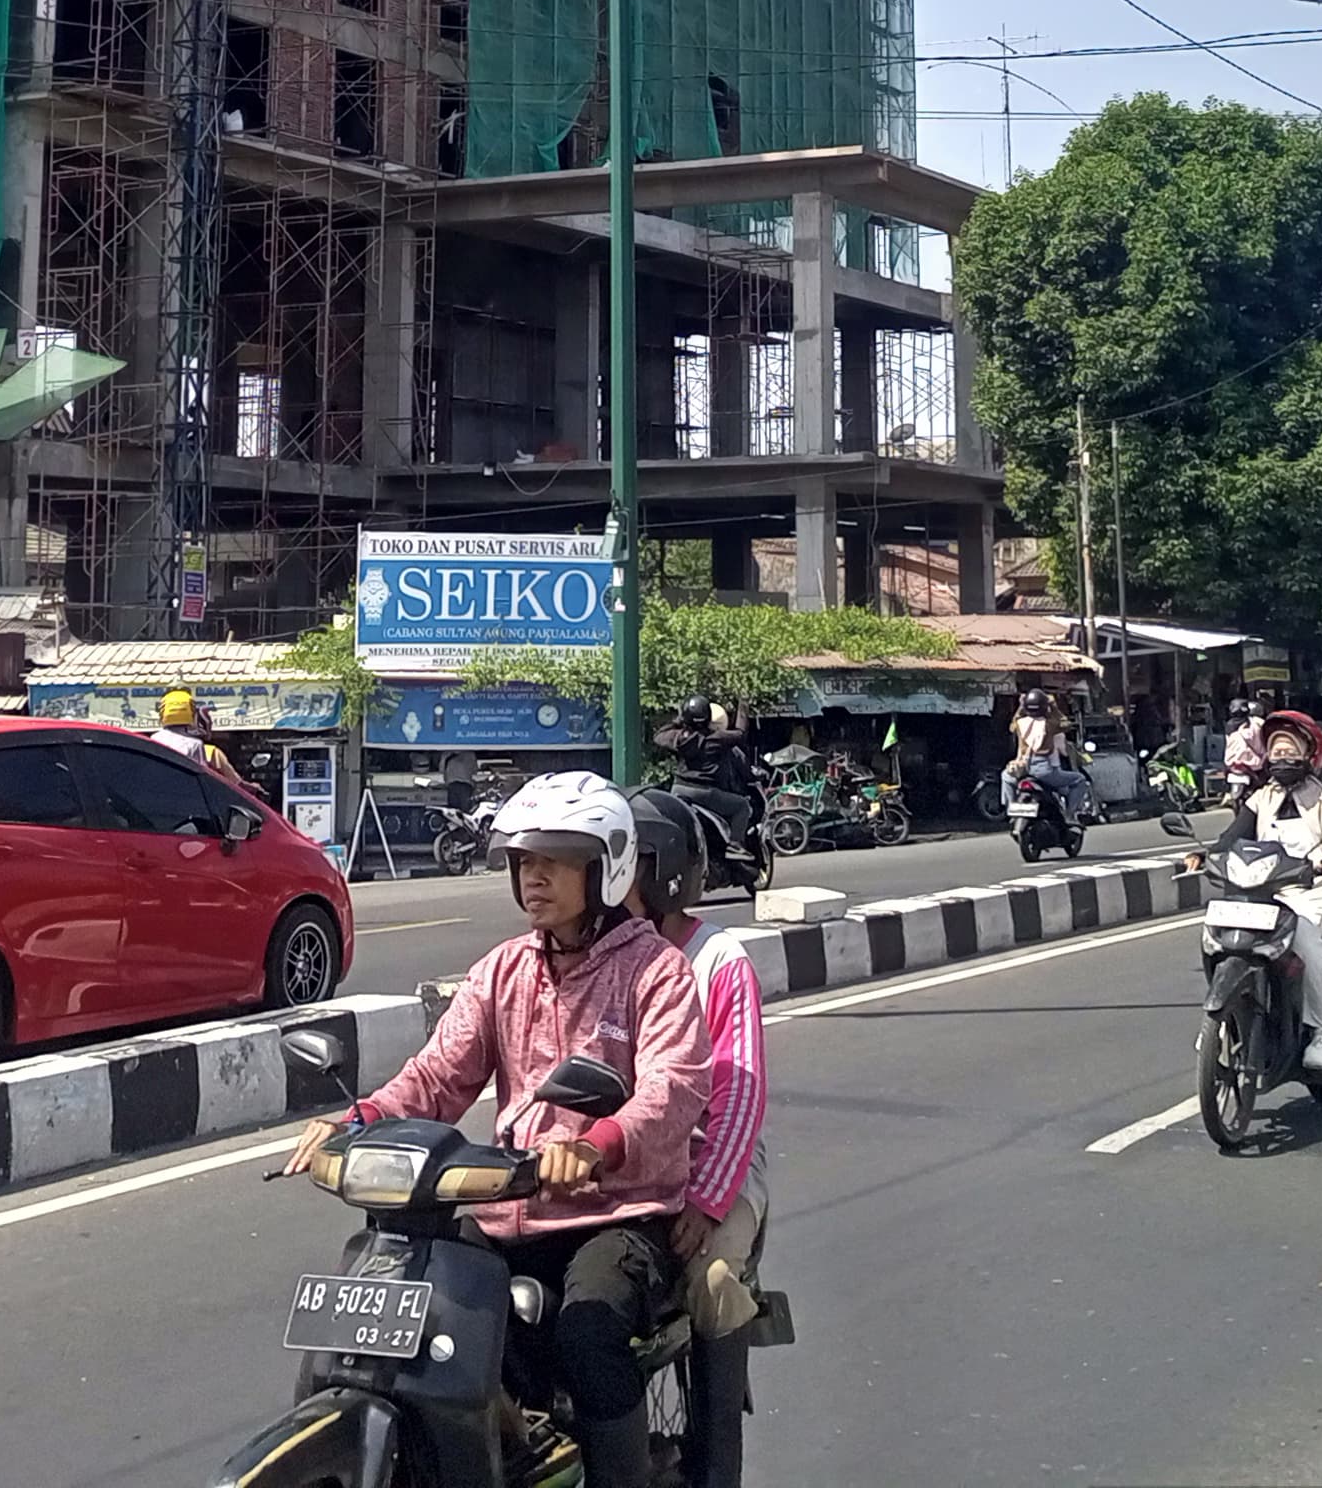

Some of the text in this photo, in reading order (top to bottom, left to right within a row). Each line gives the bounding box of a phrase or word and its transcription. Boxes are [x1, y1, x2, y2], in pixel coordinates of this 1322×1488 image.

[23, 339, 32, 356] 2
[369, 539, 600, 557] TOKO DAN PUSAT SERVIS ARL
[397, 567, 598, 623] SEIKO
[383, 627, 433, 639] (CABANG
[435, 628, 481, 639] SULTAN
[368, 647, 430, 657] MENERIMA
[297, 1282, 423, 1318] AB 5029 FL
